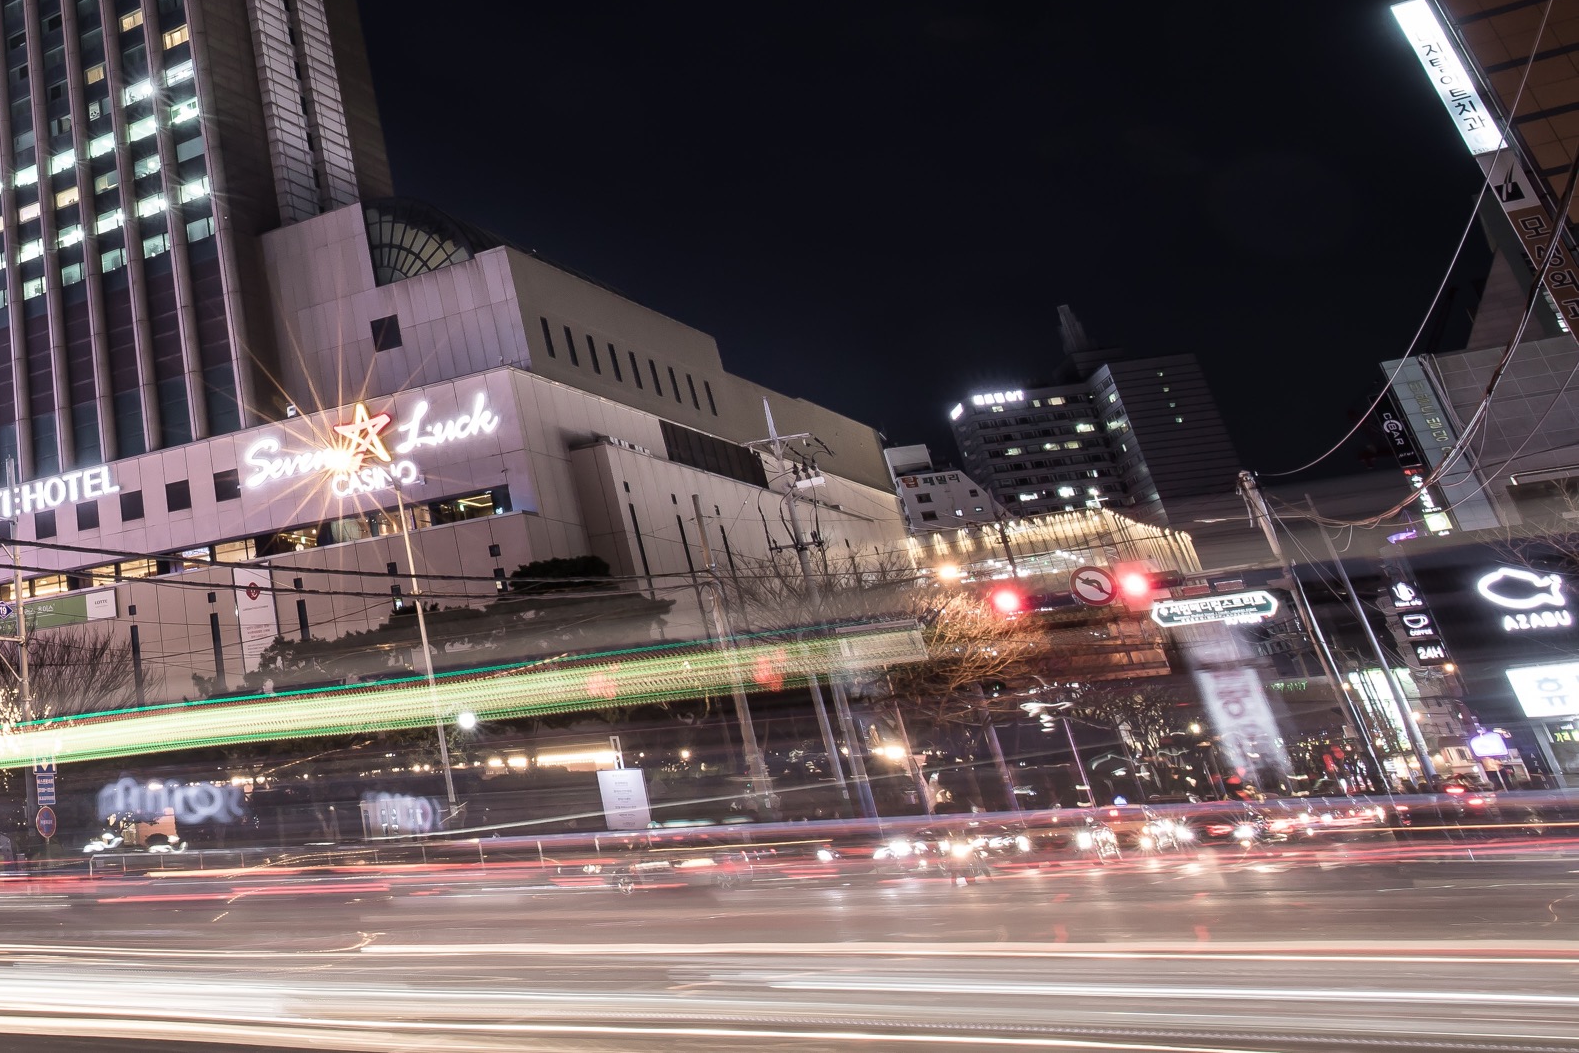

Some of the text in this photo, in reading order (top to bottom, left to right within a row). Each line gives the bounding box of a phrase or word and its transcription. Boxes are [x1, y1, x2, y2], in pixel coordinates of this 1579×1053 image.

[395, 392, 500, 454] Luck
[22, 465, 120, 514] HOTEL
[331, 460, 418, 497] CASINO
[0, 606, 8, 614] 19
[1503, 609, 1573, 632] AZABU
[1417, 646, 1445, 660] 24H
